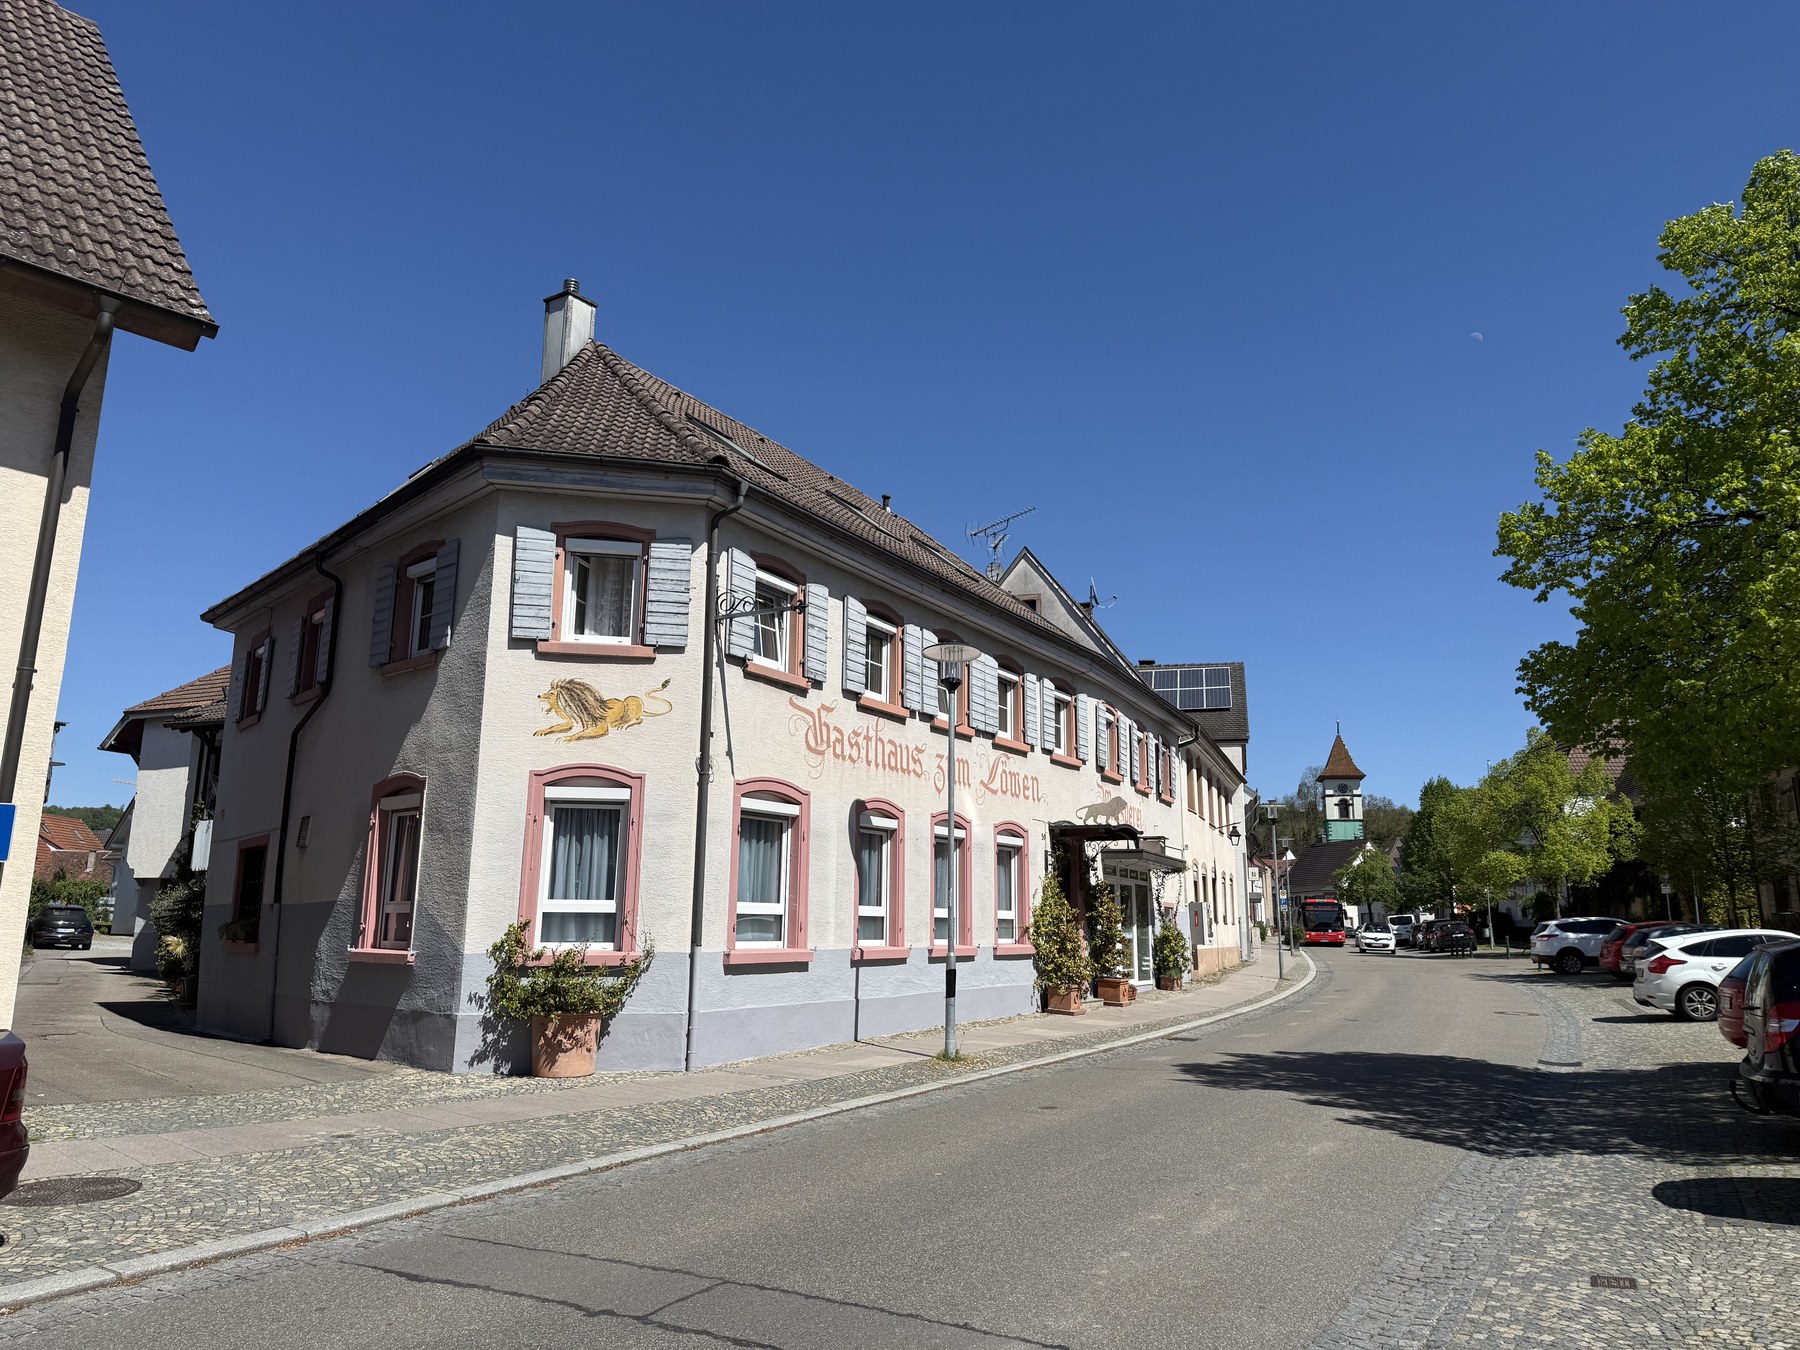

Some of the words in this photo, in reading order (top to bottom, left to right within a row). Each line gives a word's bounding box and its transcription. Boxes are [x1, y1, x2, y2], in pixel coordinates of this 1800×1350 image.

[788, 695, 928, 779] Gasthaus
[933, 753, 971, 796] zm
[977, 748, 1046, 804] Löwen
